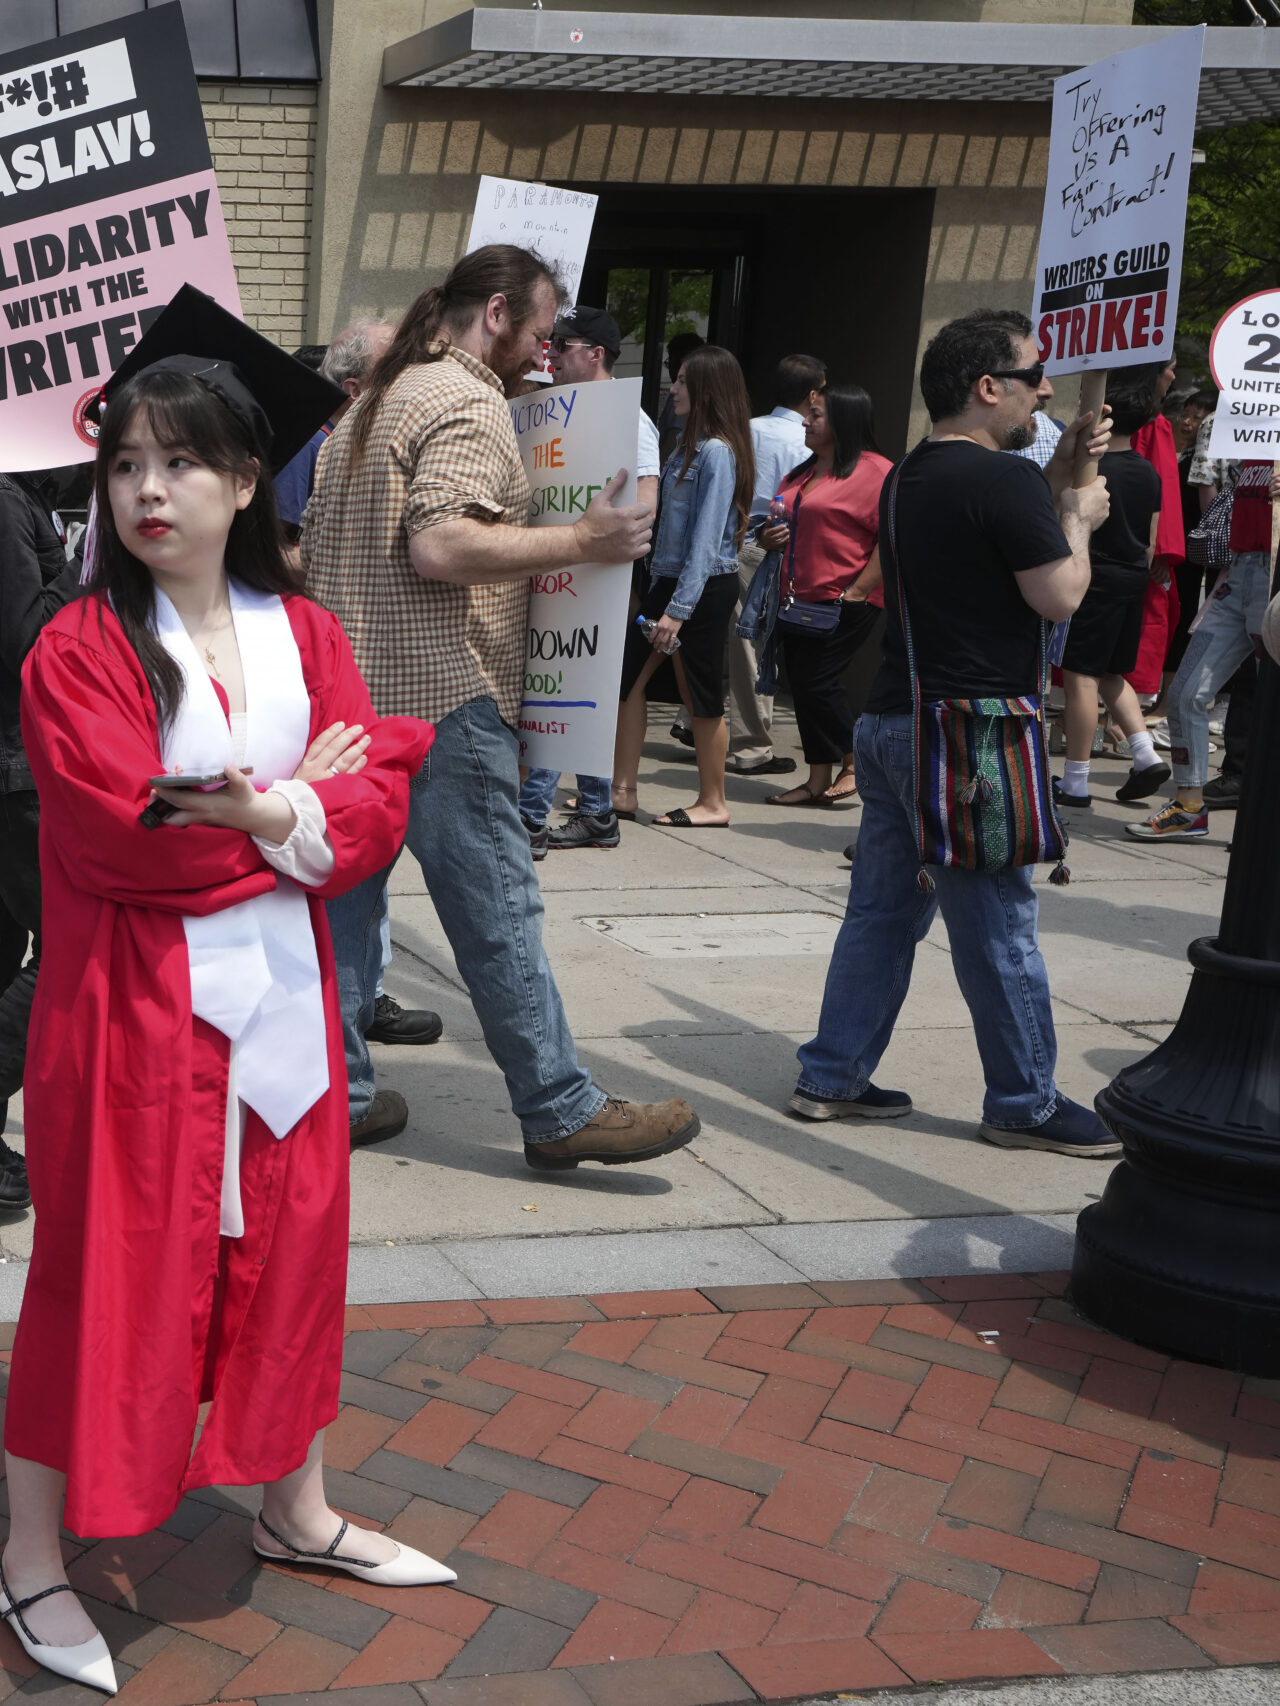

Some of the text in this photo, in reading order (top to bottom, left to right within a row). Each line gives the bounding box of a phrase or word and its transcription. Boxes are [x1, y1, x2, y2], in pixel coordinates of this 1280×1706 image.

[1065, 79, 1102, 122] Try
[1108, 133, 1130, 166] A
[1044, 241, 1171, 291] WRITERS GUILD
[2, 267, 149, 330] WITH THE
[1085, 282, 1105, 301] ON
[1037, 290, 1168, 364] STRIKE!
[1241, 310, 1280, 329] LO
[1243, 333, 1280, 374] 2
[1231, 378, 1280, 394] UNITE
[1230, 401, 1280, 417] SUPP
[1233, 428, 1280, 444] WRIT
[532, 437, 566, 470] THE
[529, 624, 599, 661] DOWN
[522, 670, 563, 695] OOD!
